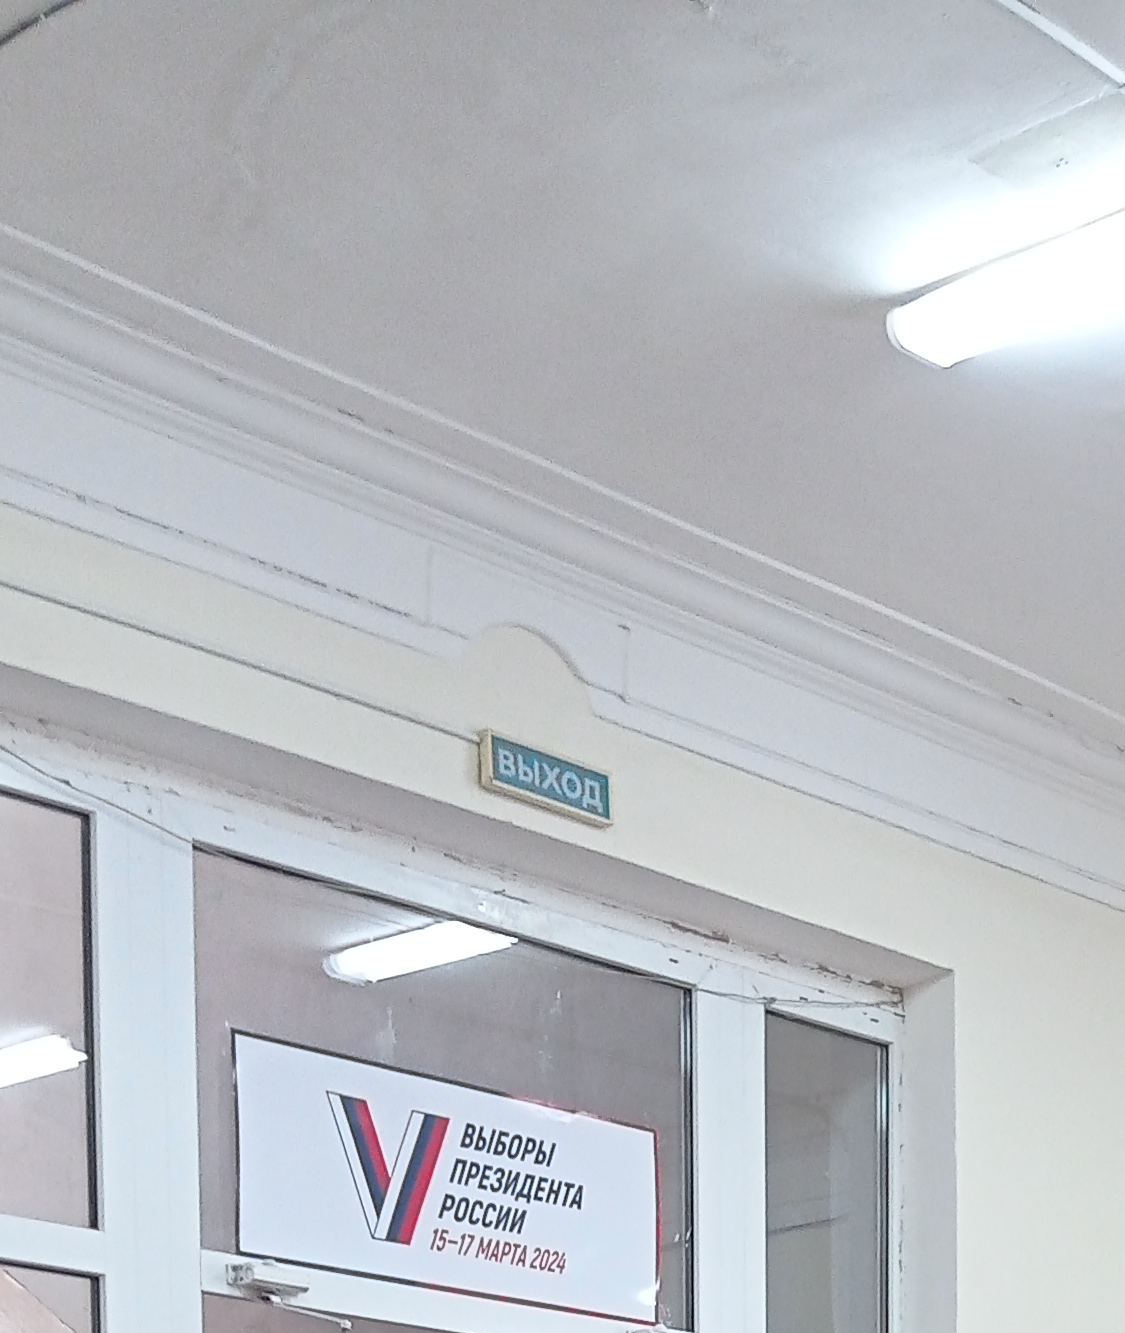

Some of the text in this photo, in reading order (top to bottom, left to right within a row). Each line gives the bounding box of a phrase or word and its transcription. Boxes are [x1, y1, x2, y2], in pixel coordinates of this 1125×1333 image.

[497, 747, 603, 813] ВЫХОД
[460, 1122, 557, 1167] ВЫБОРЫ
[449, 1157, 585, 1211] ПРЕЗИДЕНТА
[438, 1192, 528, 1235] РОССИИ
[474, 1235, 528, 1268] МАРТА
[529, 1247, 568, 1275] 2024
